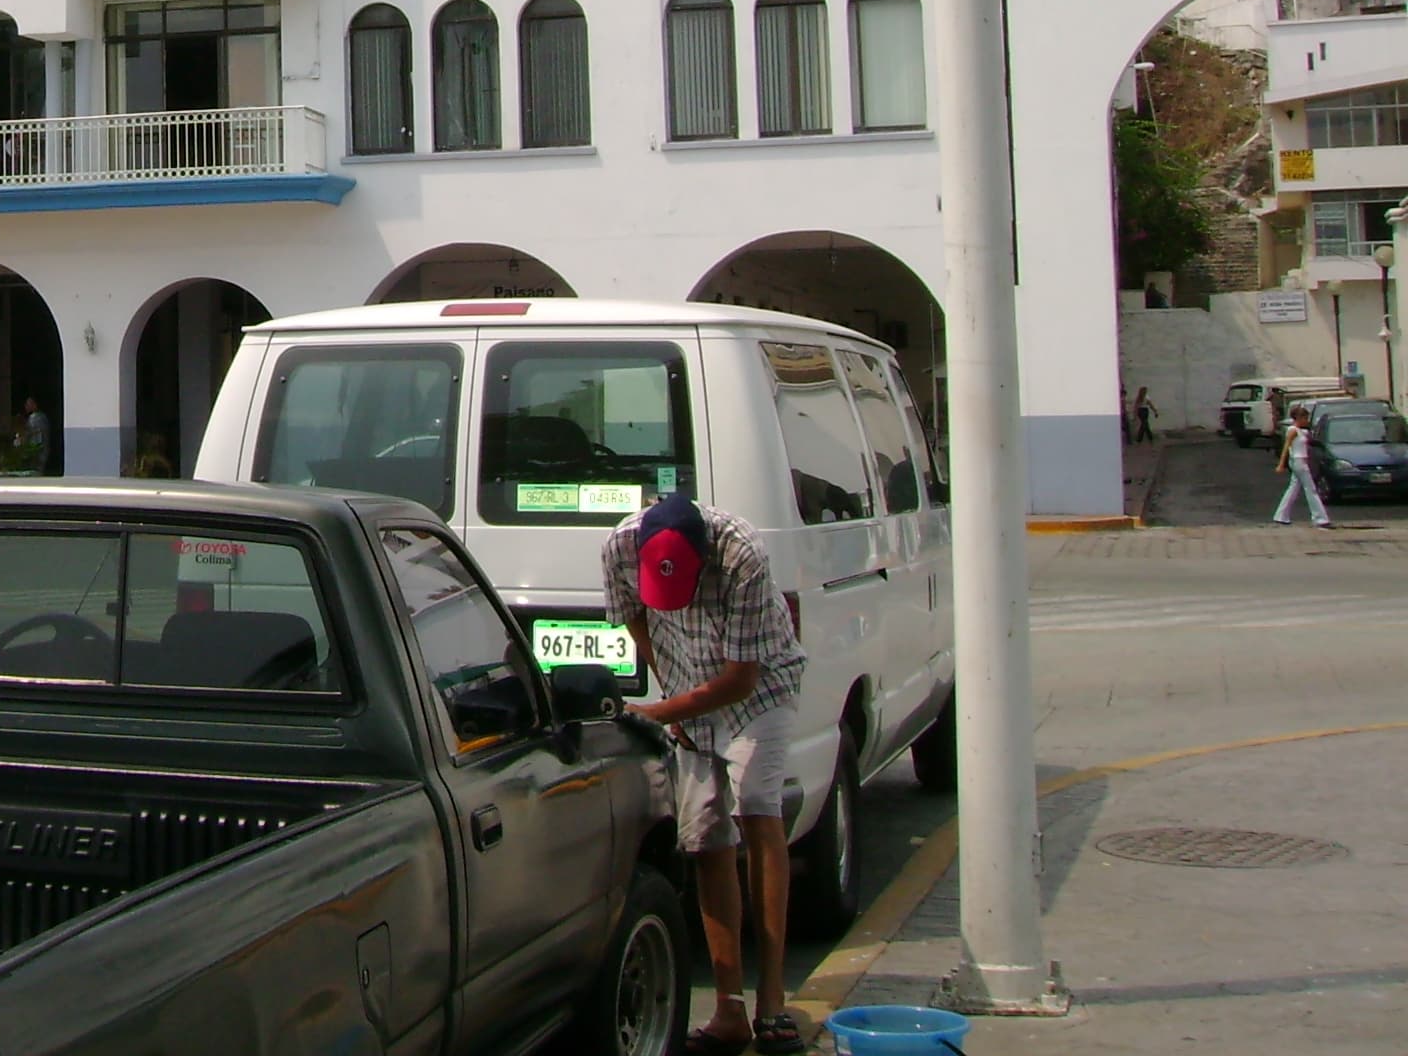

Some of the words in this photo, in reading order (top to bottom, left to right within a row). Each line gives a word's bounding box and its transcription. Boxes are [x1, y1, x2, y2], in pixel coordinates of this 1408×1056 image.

[494, 285, 555, 298] Paisano
[195, 554, 232, 565] Colima
[541, 635, 626, 658] 967-RL-3
